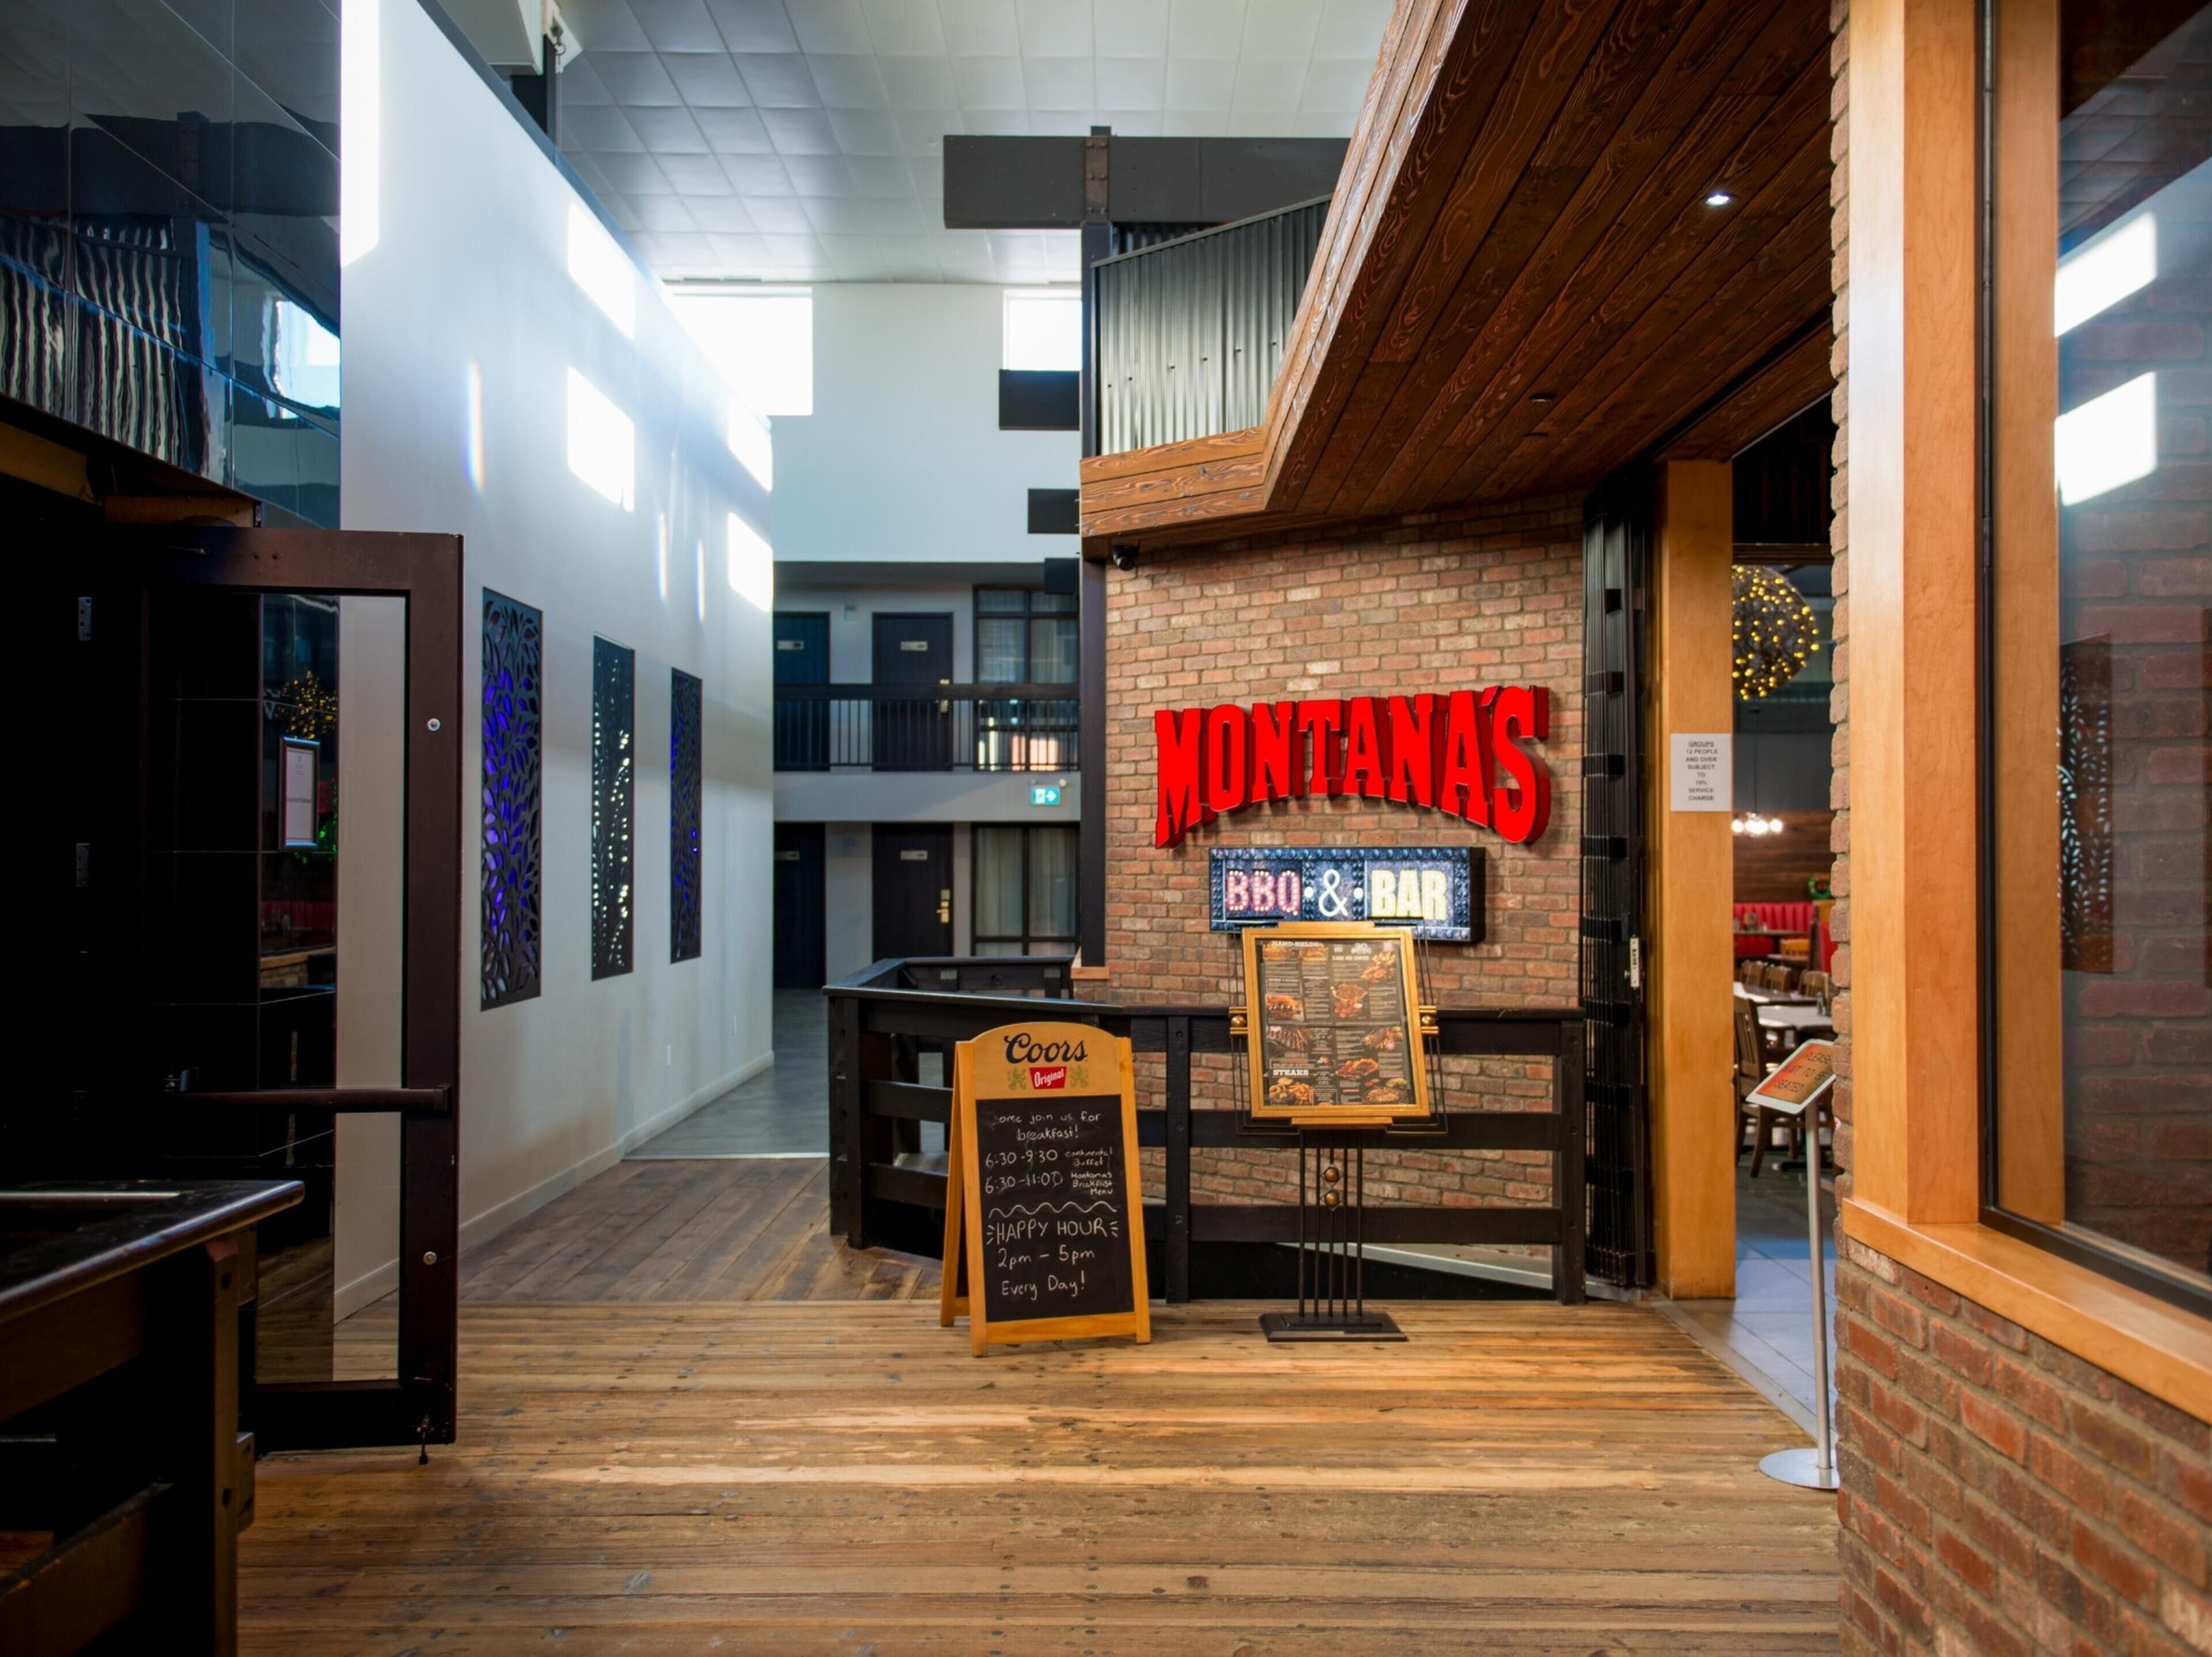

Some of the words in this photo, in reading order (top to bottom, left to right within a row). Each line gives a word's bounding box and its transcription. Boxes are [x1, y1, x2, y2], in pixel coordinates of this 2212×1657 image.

[1154, 686, 1550, 849] MONTANA'S
[1225, 869, 1300, 918] BBQ
[1318, 869, 1349, 917] &
[1371, 869, 1448, 921] BAR
[1003, 1033, 1088, 1064] Coors
[1034, 1068, 1065, 1087] Original
[1030, 1113, 1053, 1124] join
[1060, 1113, 1072, 1122] us
[1081, 1111, 1101, 1122] for
[1017, 1125, 1079, 1141] breakfast!
[997, 1219, 1048, 1245] HAPPY
[1057, 1217, 1108, 1238] HOUR
[998, 1247, 1032, 1270] 2pm
[1059, 1244, 1095, 1265] 5pm
[1001, 1280, 1038, 1301] Every
[1048, 1269, 1085, 1297] Day!
